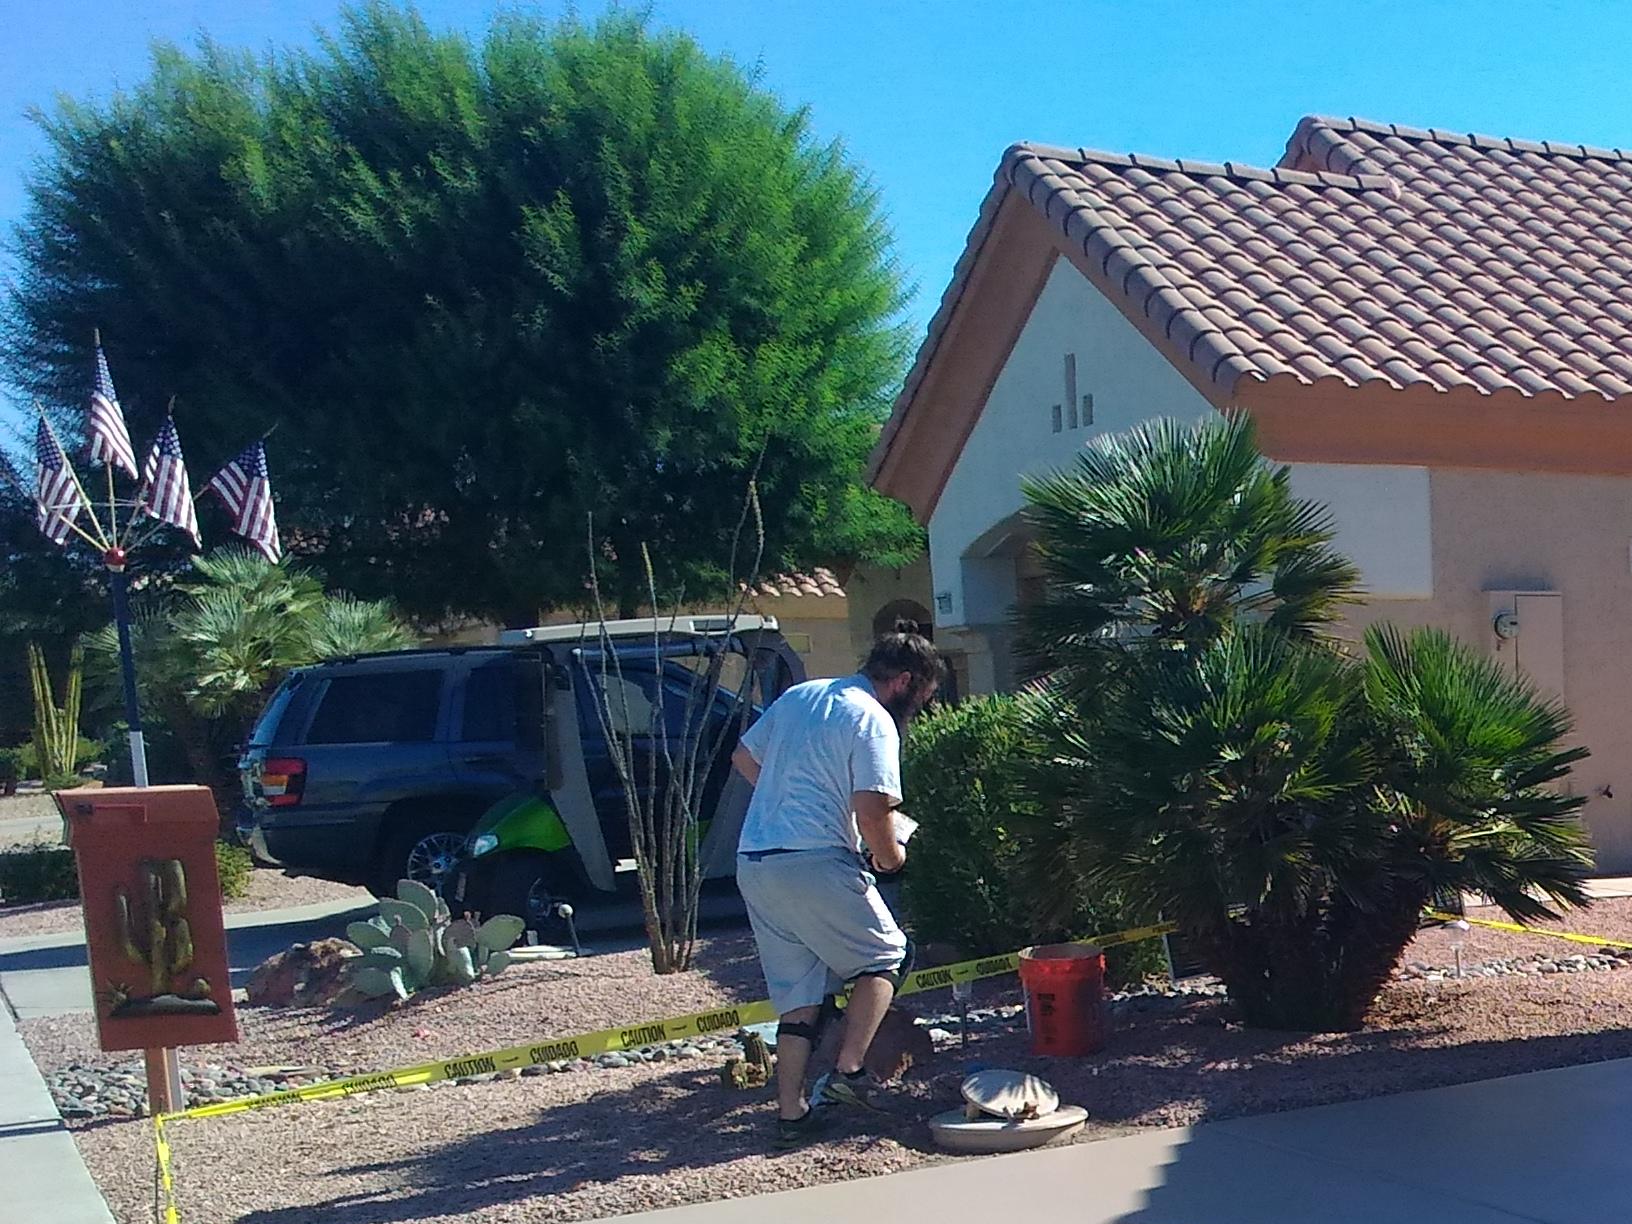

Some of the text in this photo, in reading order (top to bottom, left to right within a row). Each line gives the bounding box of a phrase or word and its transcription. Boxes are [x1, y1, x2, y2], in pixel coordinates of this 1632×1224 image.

[444, 1056, 497, 1079] CAUTION
[529, 1041, 580, 1064] CUIDADO
[620, 1024, 667, 1047] CAUTION
[696, 1009, 740, 1033] CUIDADO
